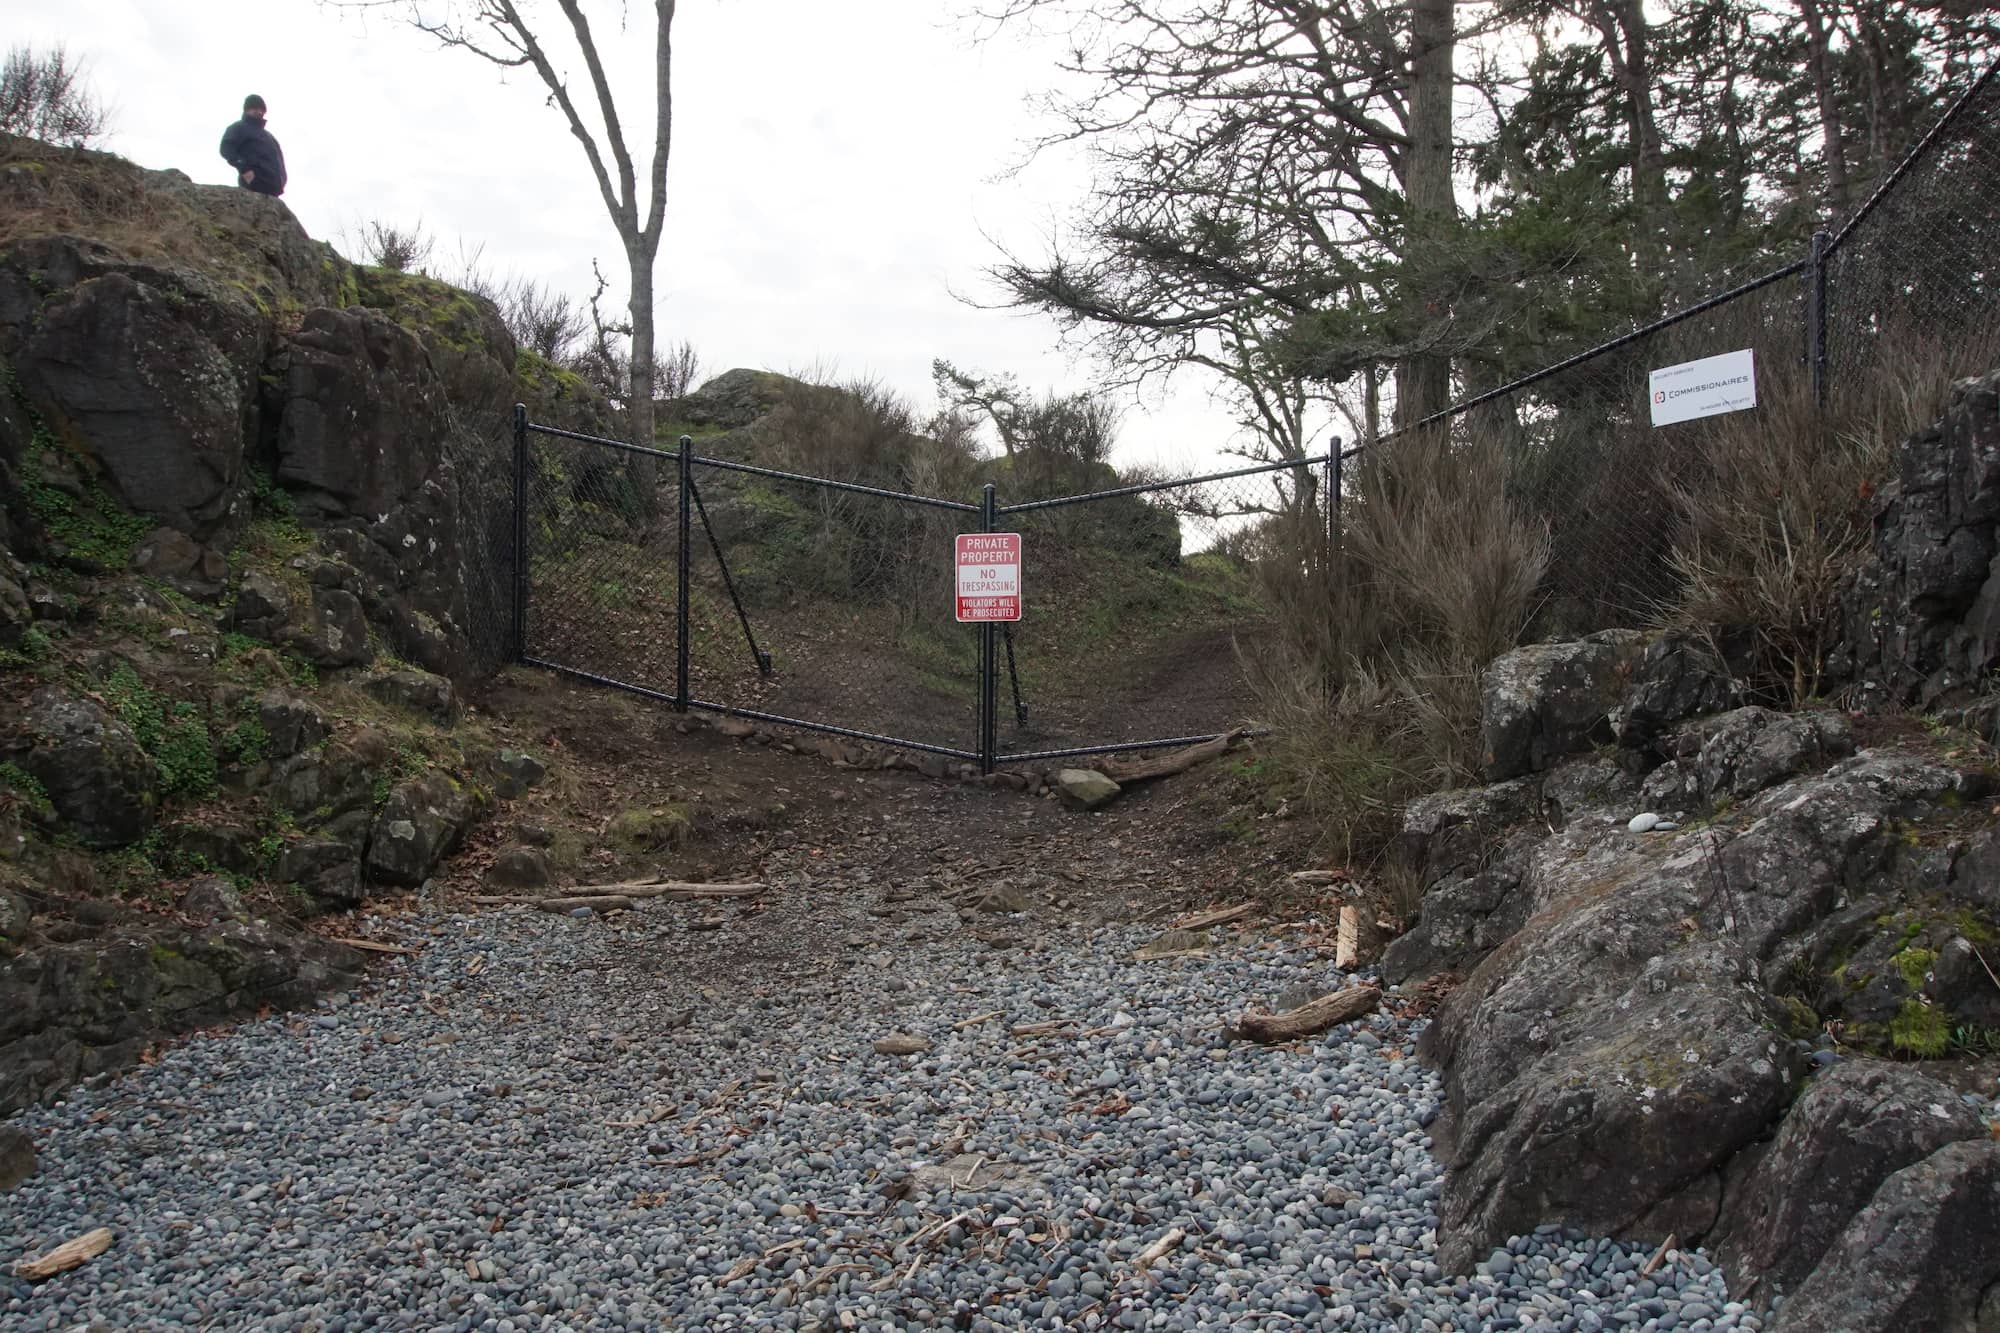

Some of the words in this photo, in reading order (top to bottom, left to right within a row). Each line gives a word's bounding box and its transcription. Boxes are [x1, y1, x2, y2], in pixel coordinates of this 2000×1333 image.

[1668, 375, 1749, 399] COMMISSIONAIRES
[967, 538, 1009, 549] PRIVATE
[961, 551, 1015, 562] PROPERTY
[980, 569, 996, 579] NO
[961, 581, 1015, 592] TRESPASSING
[962, 598, 997, 607] VIOLATORS
[999, 597, 1015, 607] WILL
[962, 608, 970, 617] BE
[973, 607, 1015, 617] PROSECUTED
